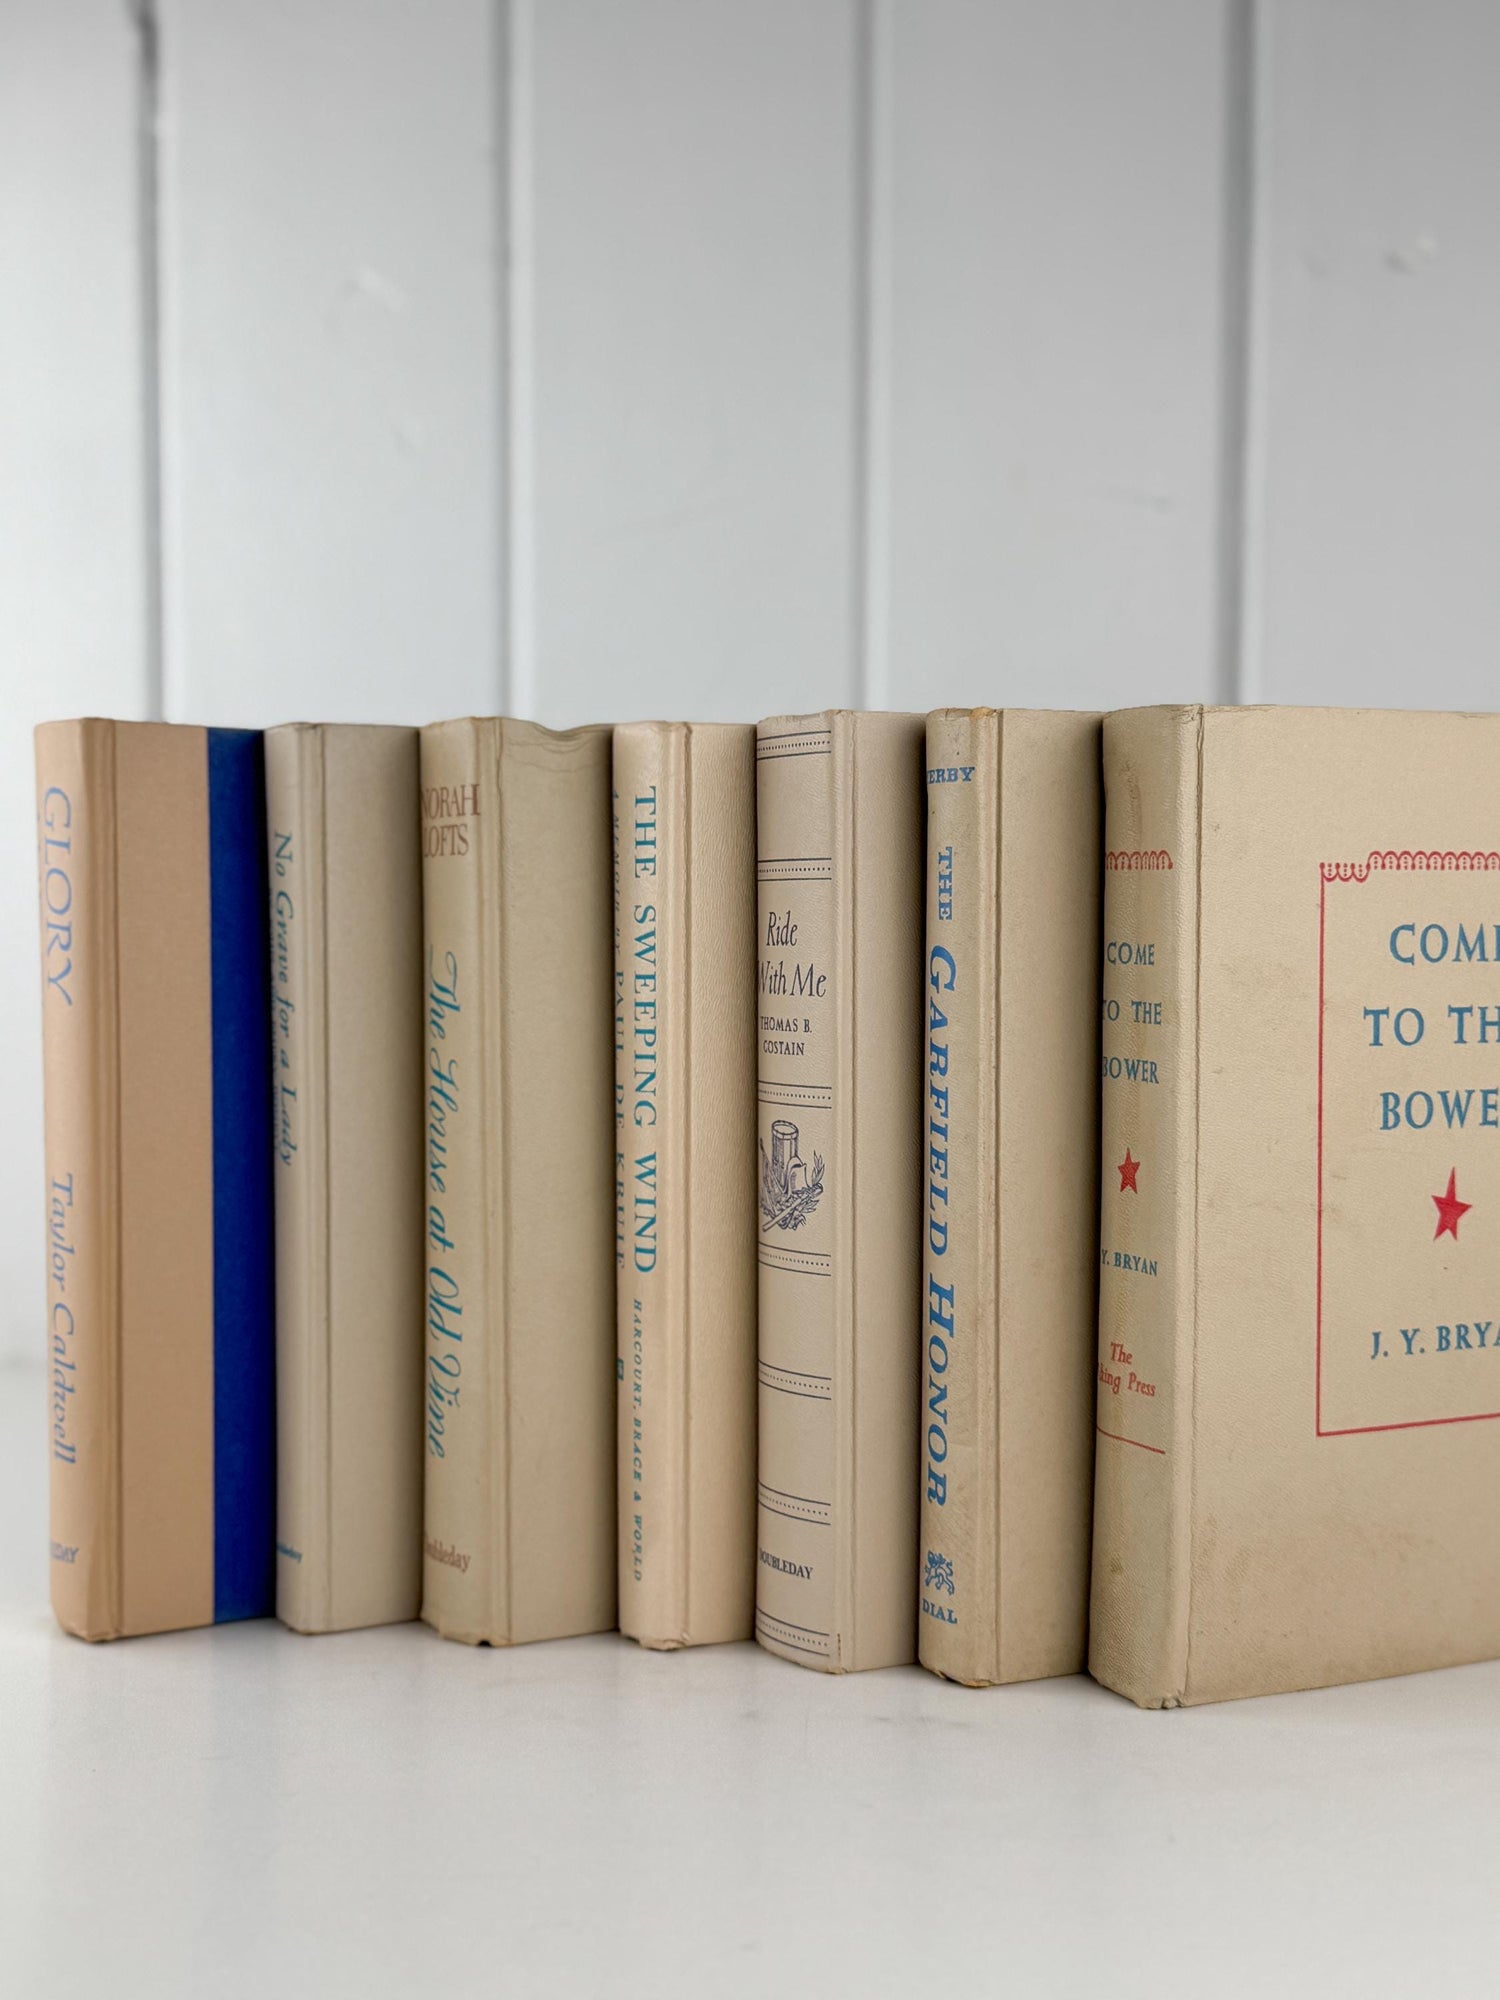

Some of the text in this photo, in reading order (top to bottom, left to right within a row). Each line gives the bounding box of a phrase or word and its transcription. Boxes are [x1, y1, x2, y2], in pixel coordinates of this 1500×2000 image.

[274, 831, 293, 877] No
[43, 786, 73, 1006] GLORY
[276, 890, 294, 983] Grave
[766, 910, 798, 946] Ride
[1107, 941, 1155, 966] COME
[790, 963, 827, 997] Me
[275, 993, 295, 1038] for
[634, 786, 657, 1273] THE SWEEPING WIND
[760, 1016, 813, 1033] THOMAS B.
[1131, 1001, 1162, 1025] THE
[1363, 1004, 1500, 1046] TO TH
[280, 1048, 290, 1068] a
[763, 1040, 805, 1056] COSTAIN
[280, 1081, 297, 1167] Lady
[1379, 1088, 1499, 1130] BOWE
[927, 846, 956, 1506] THE GARFIELD HONOR
[427, 943, 462, 1459] The House at Old Vine
[1113, 1252, 1158, 1277] BRYAN
[51, 1172, 77, 1464] Taylor Caldwell
[1110, 1342, 1133, 1364] The
[1371, 1330, 1388, 1360] J.
[1400, 1328, 1425, 1355] Y.
[1127, 1371, 1156, 1397] Press
[632, 1417, 643, 1482] BRACE
[632, 1491, 643, 1502] &
[632, 1514, 643, 1582] WORLD
[922, 1598, 957, 1624] DIAL
